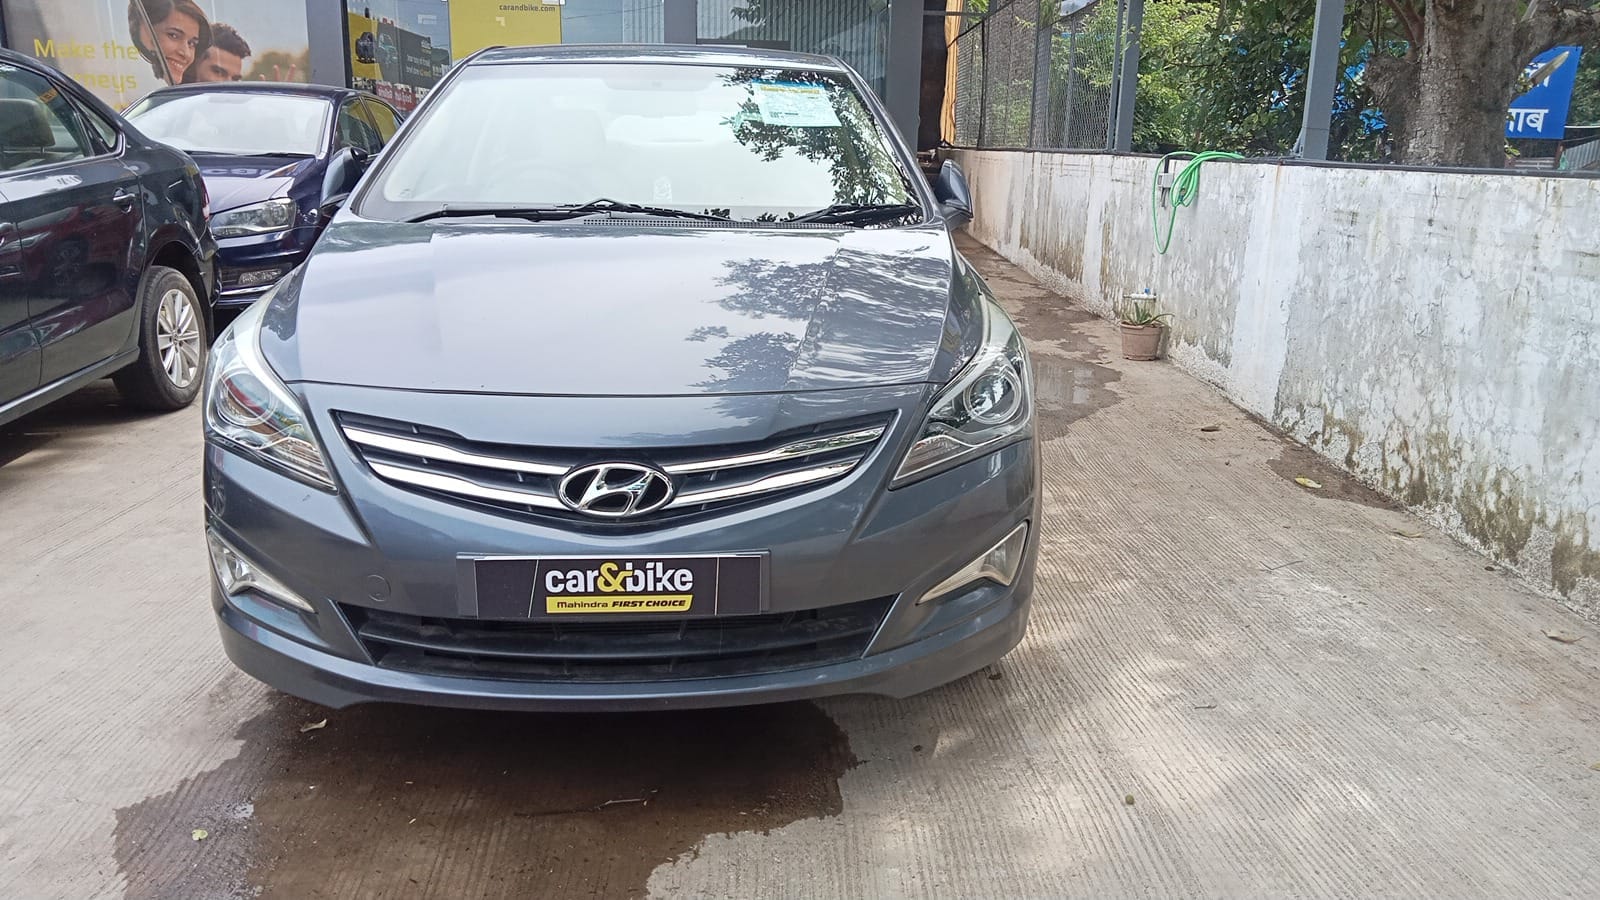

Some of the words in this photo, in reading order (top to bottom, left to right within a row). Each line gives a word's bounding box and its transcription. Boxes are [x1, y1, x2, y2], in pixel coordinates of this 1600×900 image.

[499, 4, 556, 12] carandbike.com
[33, 39, 96, 58] Make
[103, 39, 138, 60] the
[545, 562, 694, 593] car&bike
[556, 601, 608, 609] Mahindra
[611, 600, 645, 608] FIRST
[645, 599, 686, 607] CHOICE
